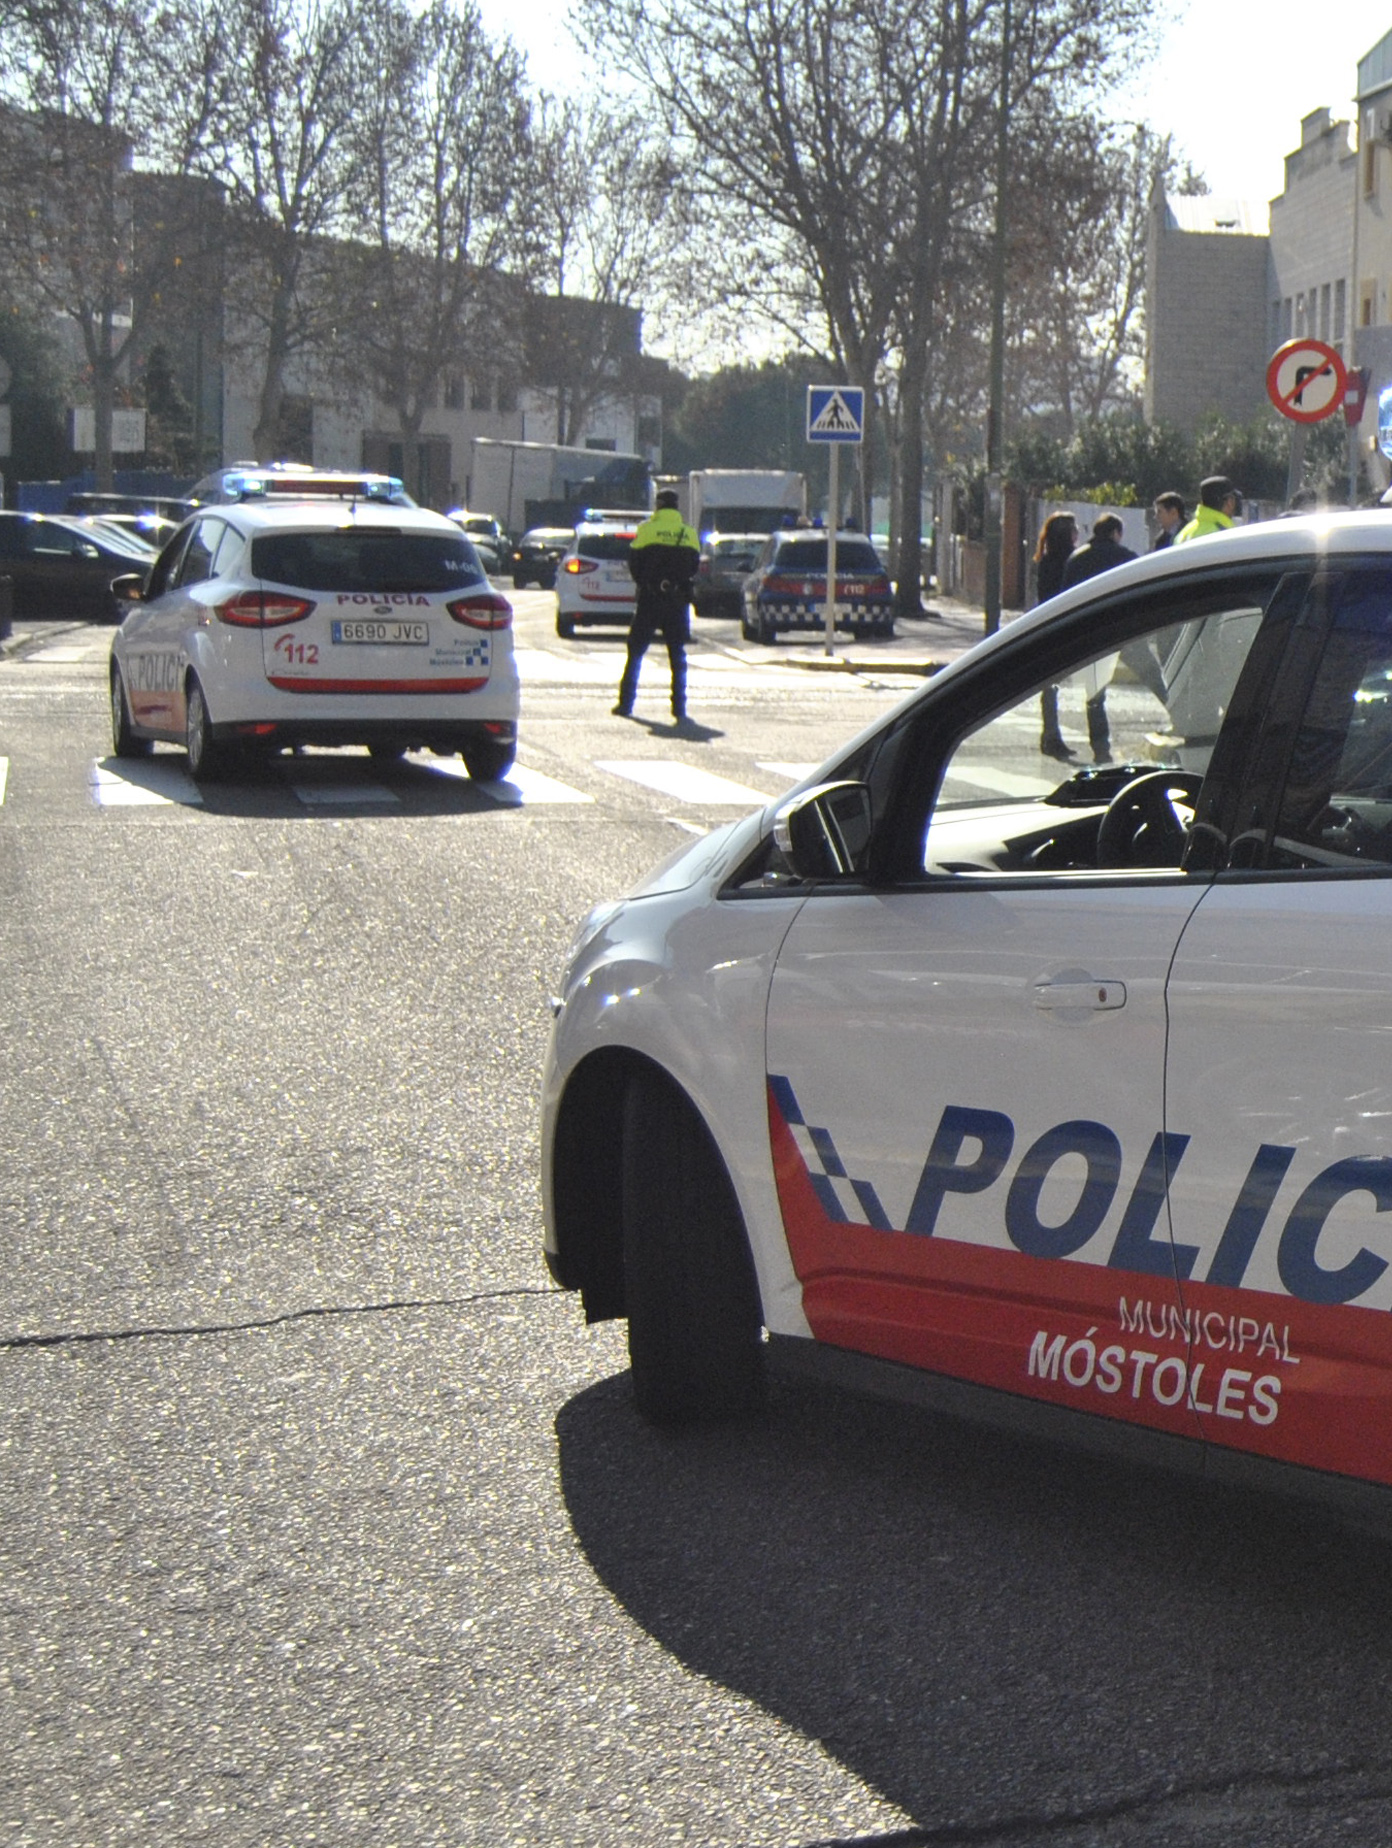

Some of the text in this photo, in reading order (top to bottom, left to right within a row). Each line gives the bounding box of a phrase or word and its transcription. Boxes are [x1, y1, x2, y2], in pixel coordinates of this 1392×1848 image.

[344, 624, 424, 640] 6690 JVC
[284, 644, 319, 665] 112
[1119, 1297, 1301, 1364] MUNICIPAL
[1028, 1326, 1283, 1426] MÓSTOLES
